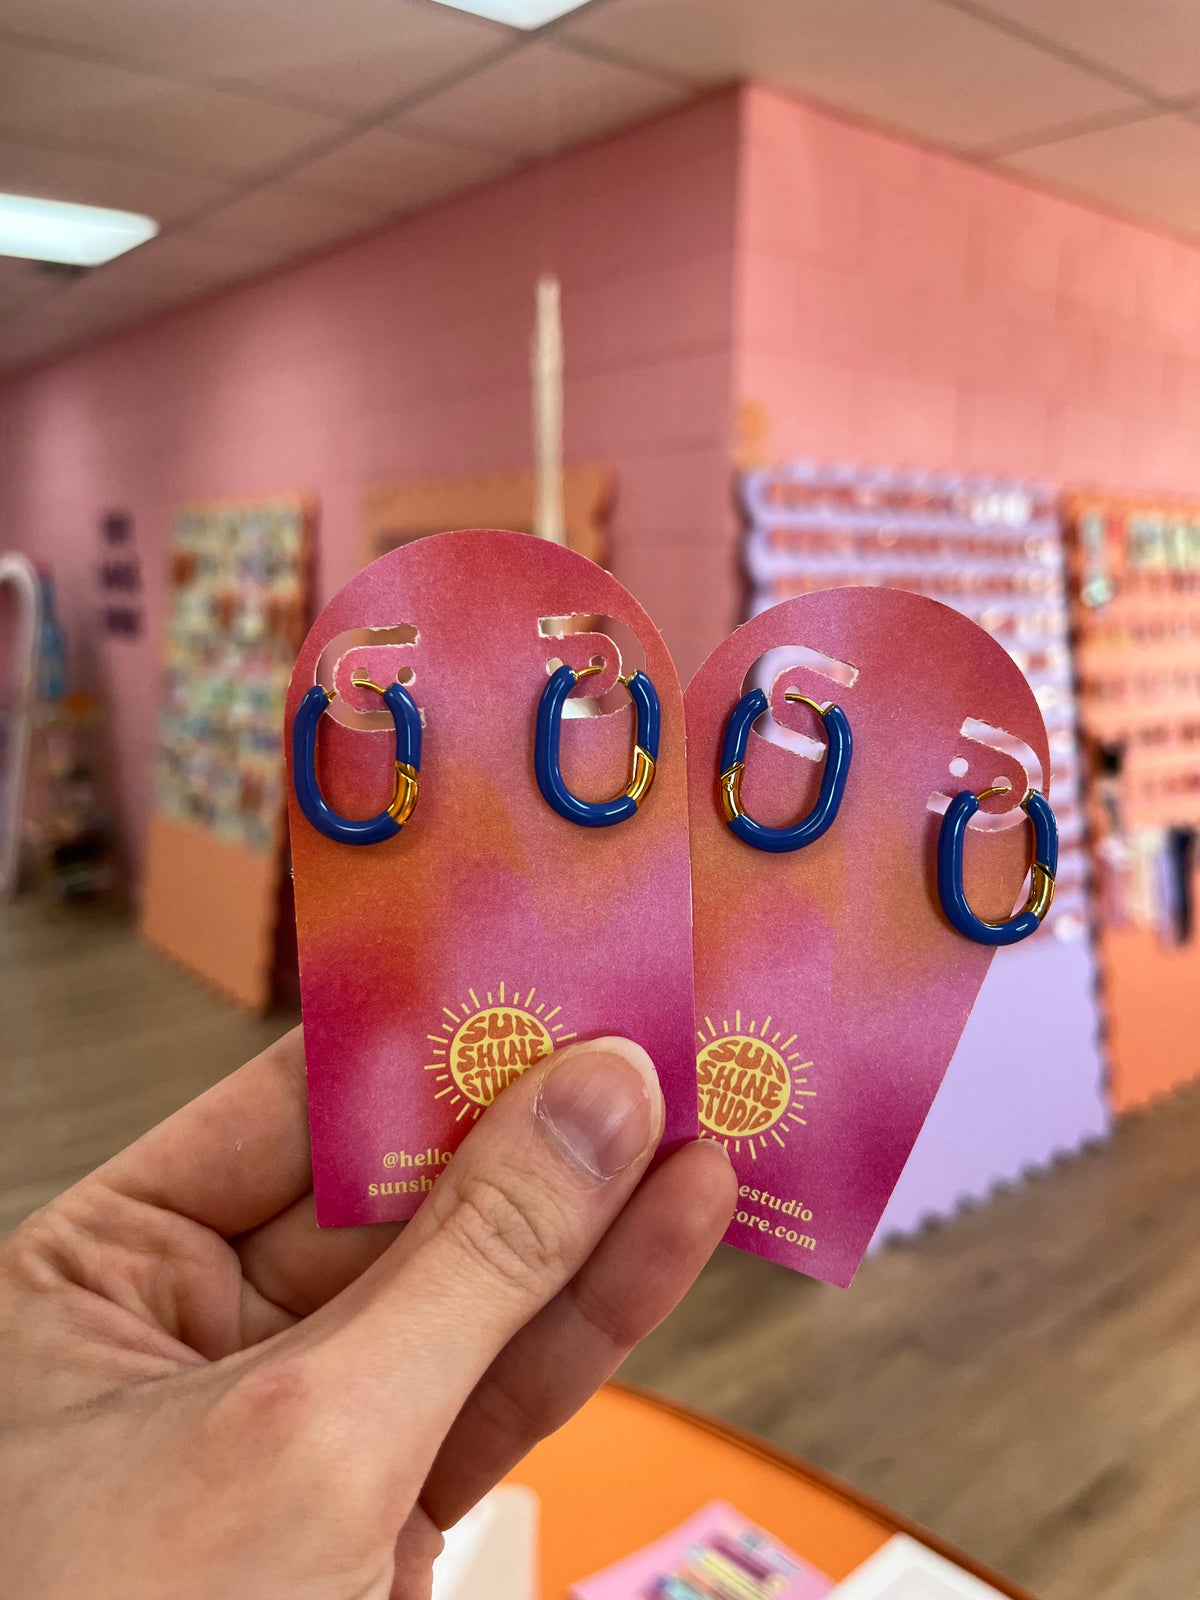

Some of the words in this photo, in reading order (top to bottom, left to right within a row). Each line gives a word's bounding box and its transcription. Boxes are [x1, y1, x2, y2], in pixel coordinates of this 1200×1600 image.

[459, 1013, 545, 1044] SUN
[456, 1038, 548, 1073] SHINE
[707, 1039, 786, 1084] SUN
[697, 1059, 783, 1109] SHINE
[368, 1173, 440, 1196] sunsh
[738, 1184, 813, 1222] estudio
[731, 1208, 817, 1251] ore.com
